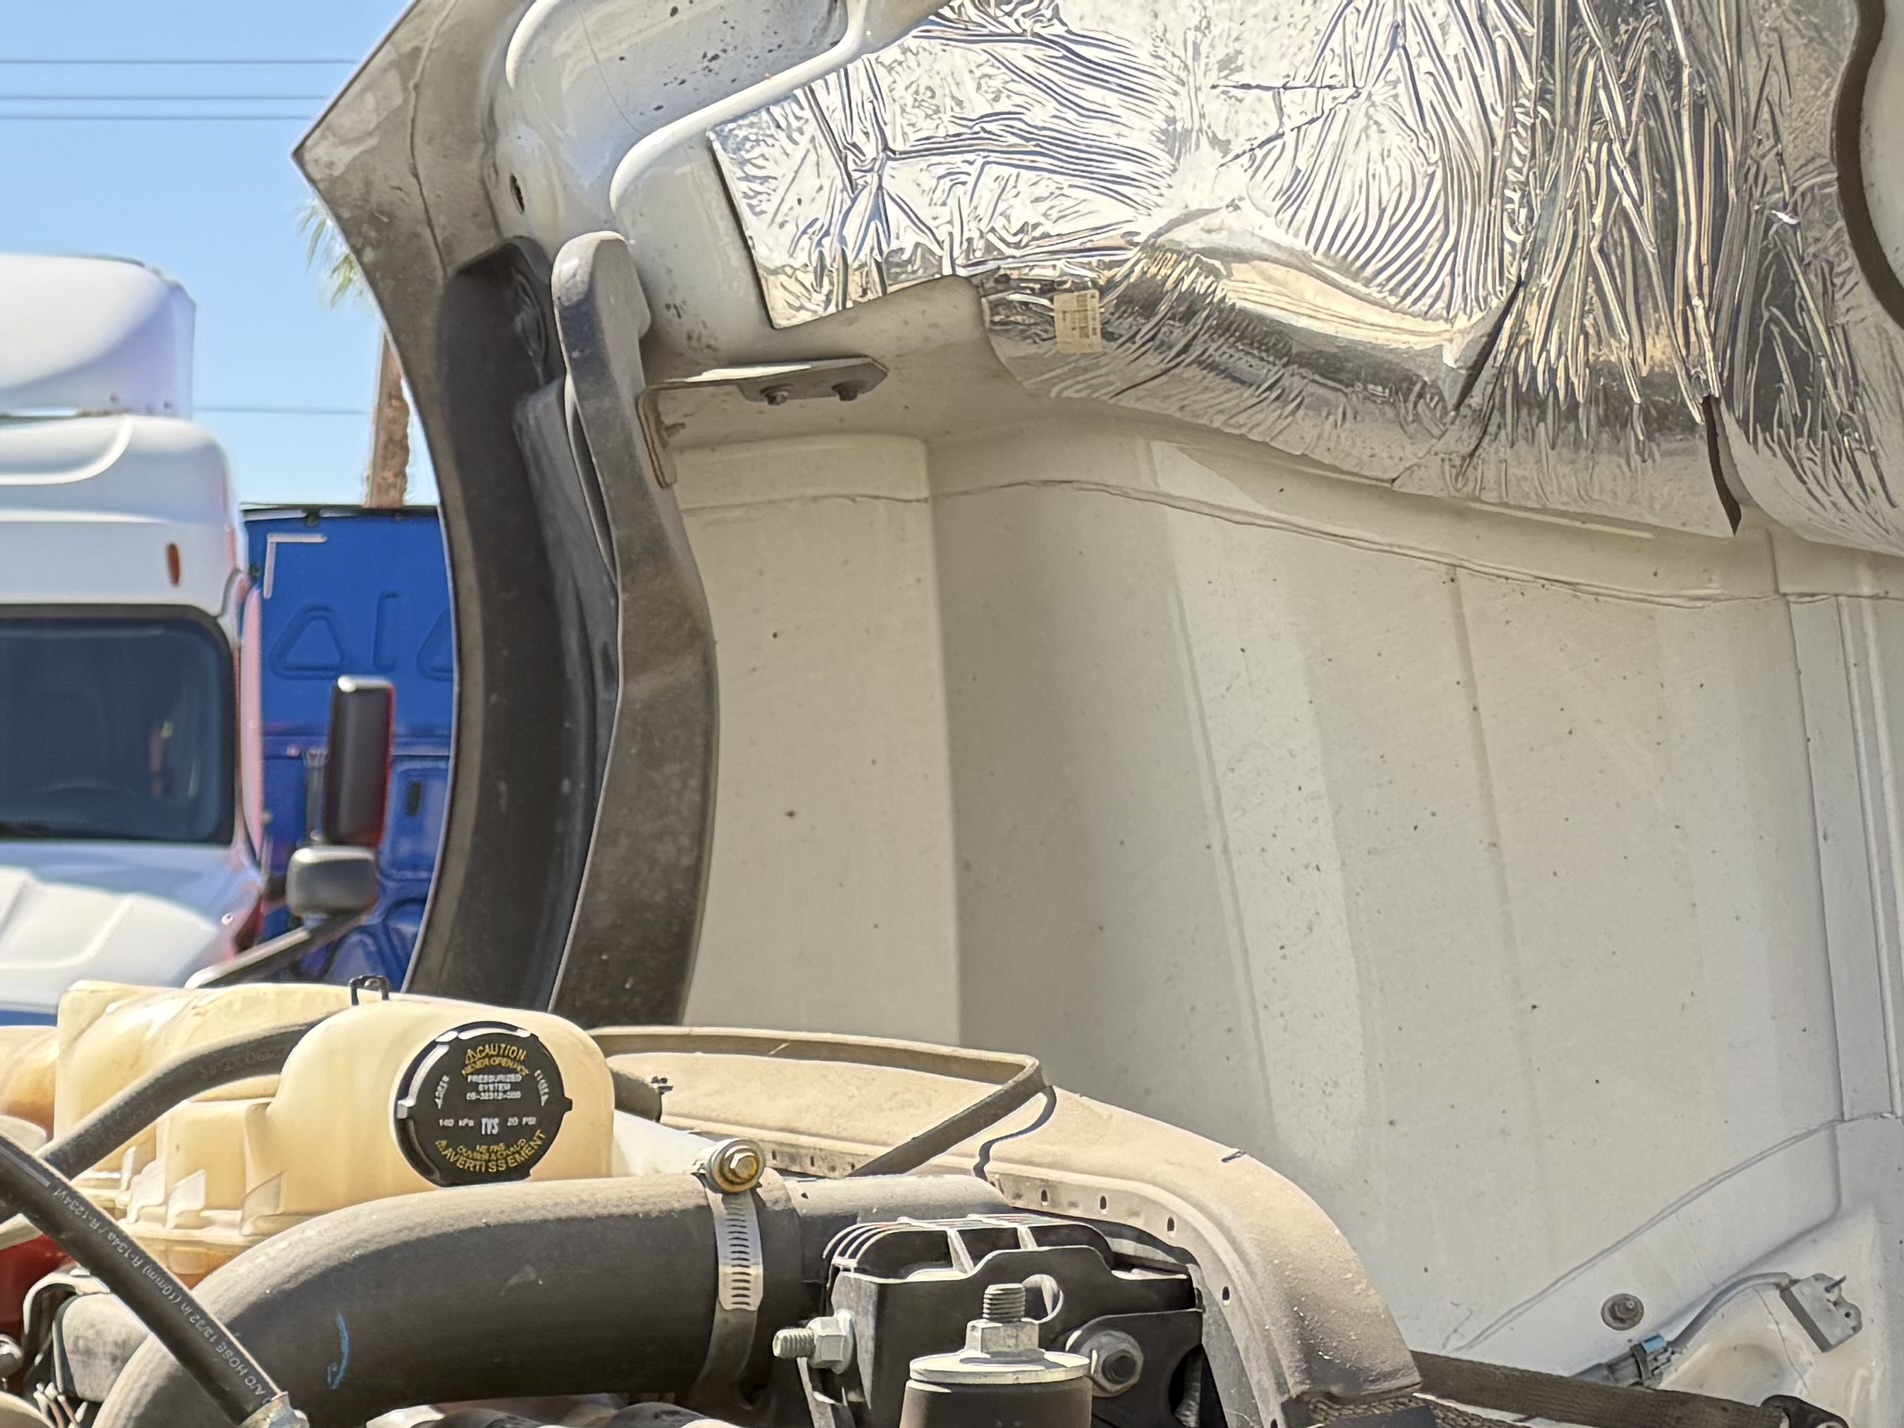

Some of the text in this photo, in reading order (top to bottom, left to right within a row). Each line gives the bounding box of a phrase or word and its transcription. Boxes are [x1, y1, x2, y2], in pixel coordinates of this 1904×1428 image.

[476, 1043, 527, 1060] CAUTION
[441, 1129, 546, 1172] AVERTISSEMENT
[142, 1266, 182, 1305] (10mm)
[215, 1342, 248, 1376] HOSE
